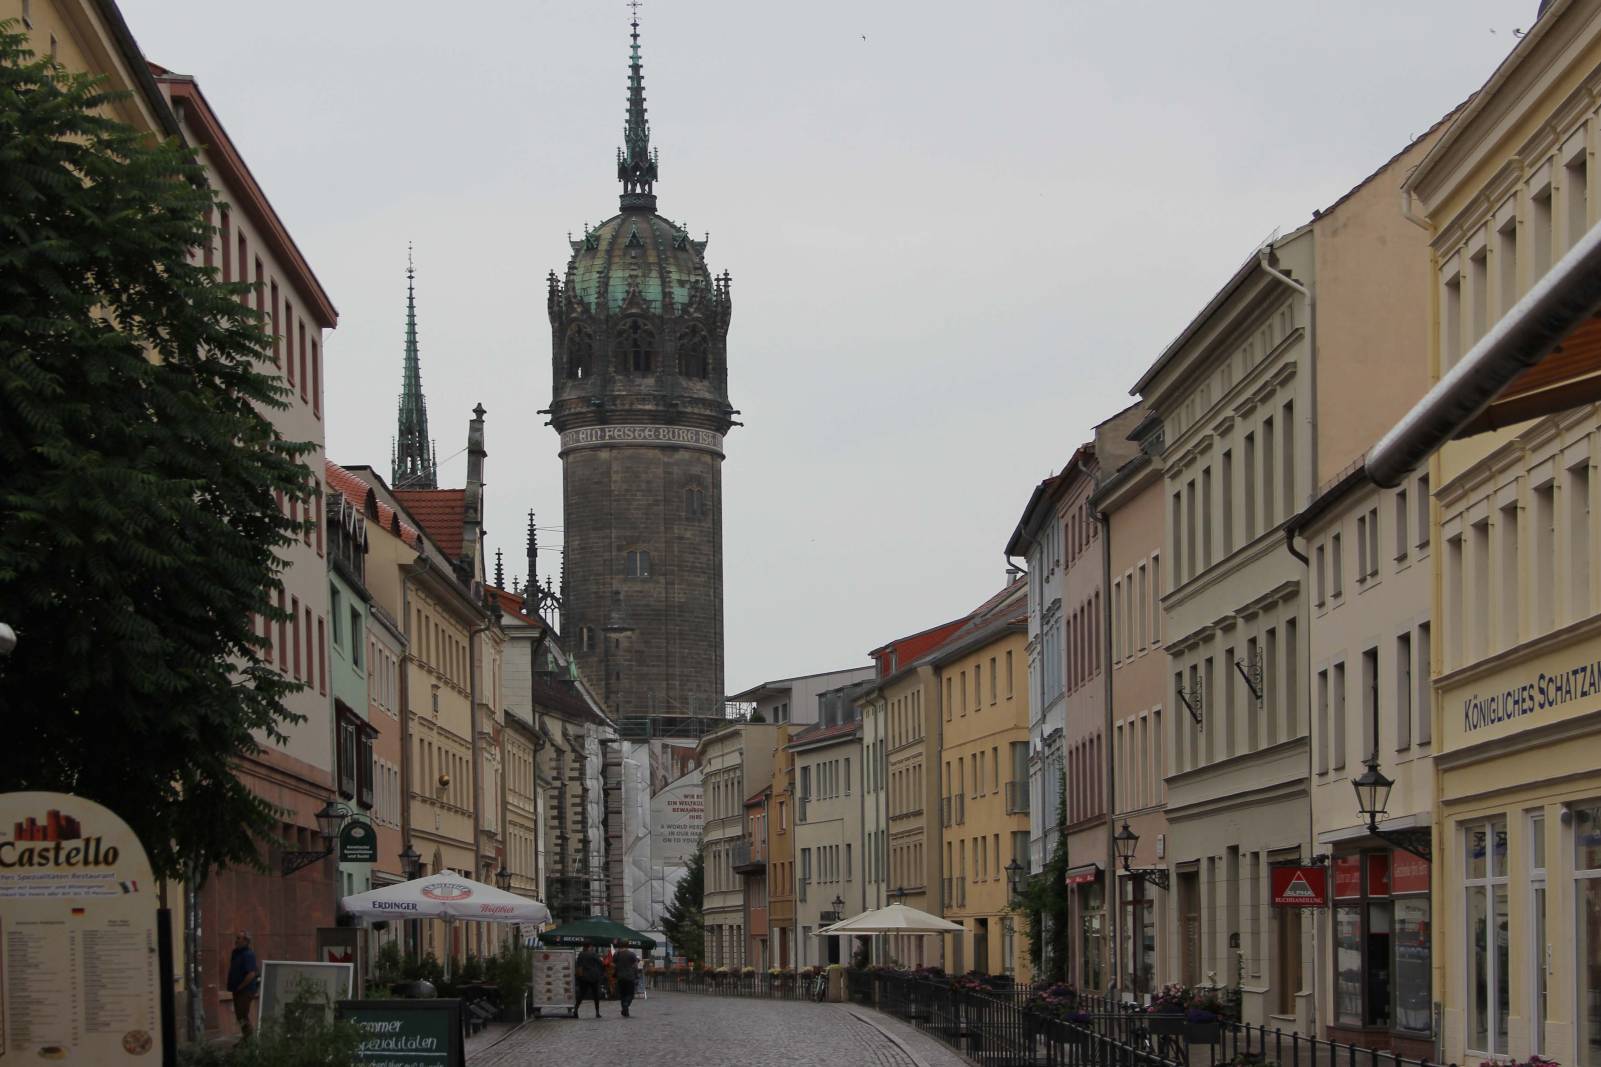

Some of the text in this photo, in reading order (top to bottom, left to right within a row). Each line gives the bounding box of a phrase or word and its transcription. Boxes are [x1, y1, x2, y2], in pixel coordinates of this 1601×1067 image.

[579, 429, 600, 442] EIN
[605, 426, 656, 441] FESTE
[659, 427, 696, 442] BURG
[1464, 661, 1601, 732] KÖNIGLICHES SCHATZA
[0, 837, 119, 868] Castello
[372, 900, 418, 912] ERDINGER
